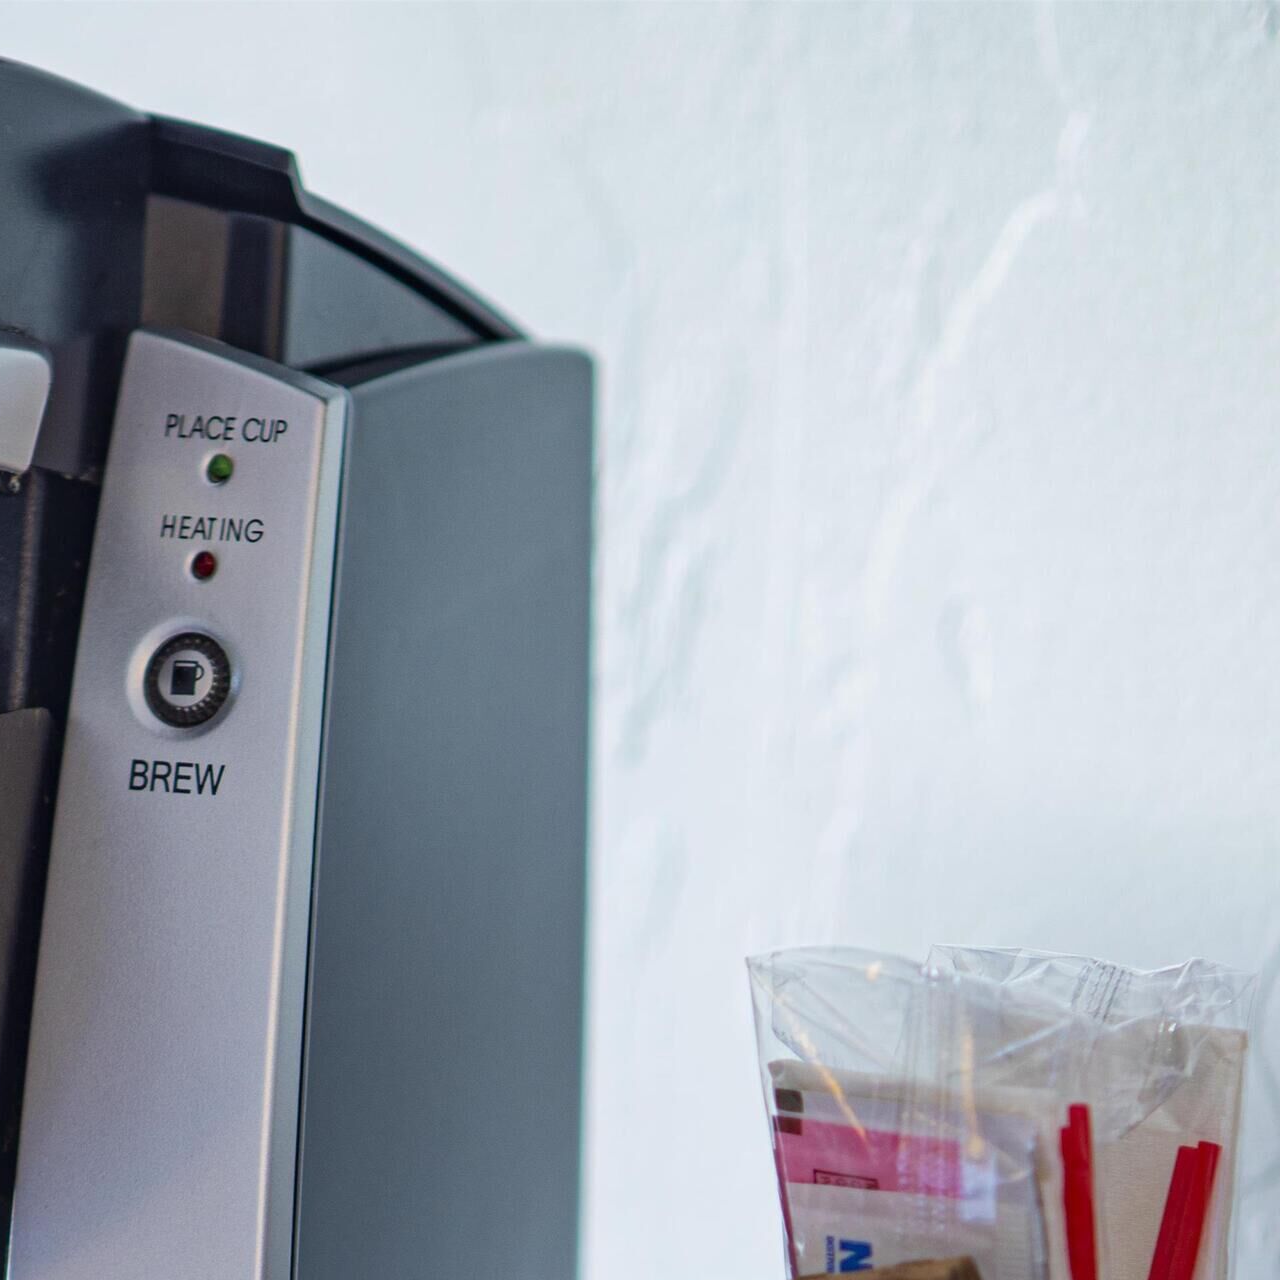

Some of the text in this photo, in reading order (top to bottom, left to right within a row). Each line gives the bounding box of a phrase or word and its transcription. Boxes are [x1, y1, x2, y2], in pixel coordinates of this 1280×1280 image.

[164, 413, 289, 443] PLACE CUP
[160, 514, 265, 544] HEATING
[128, 758, 226, 797] BREW
